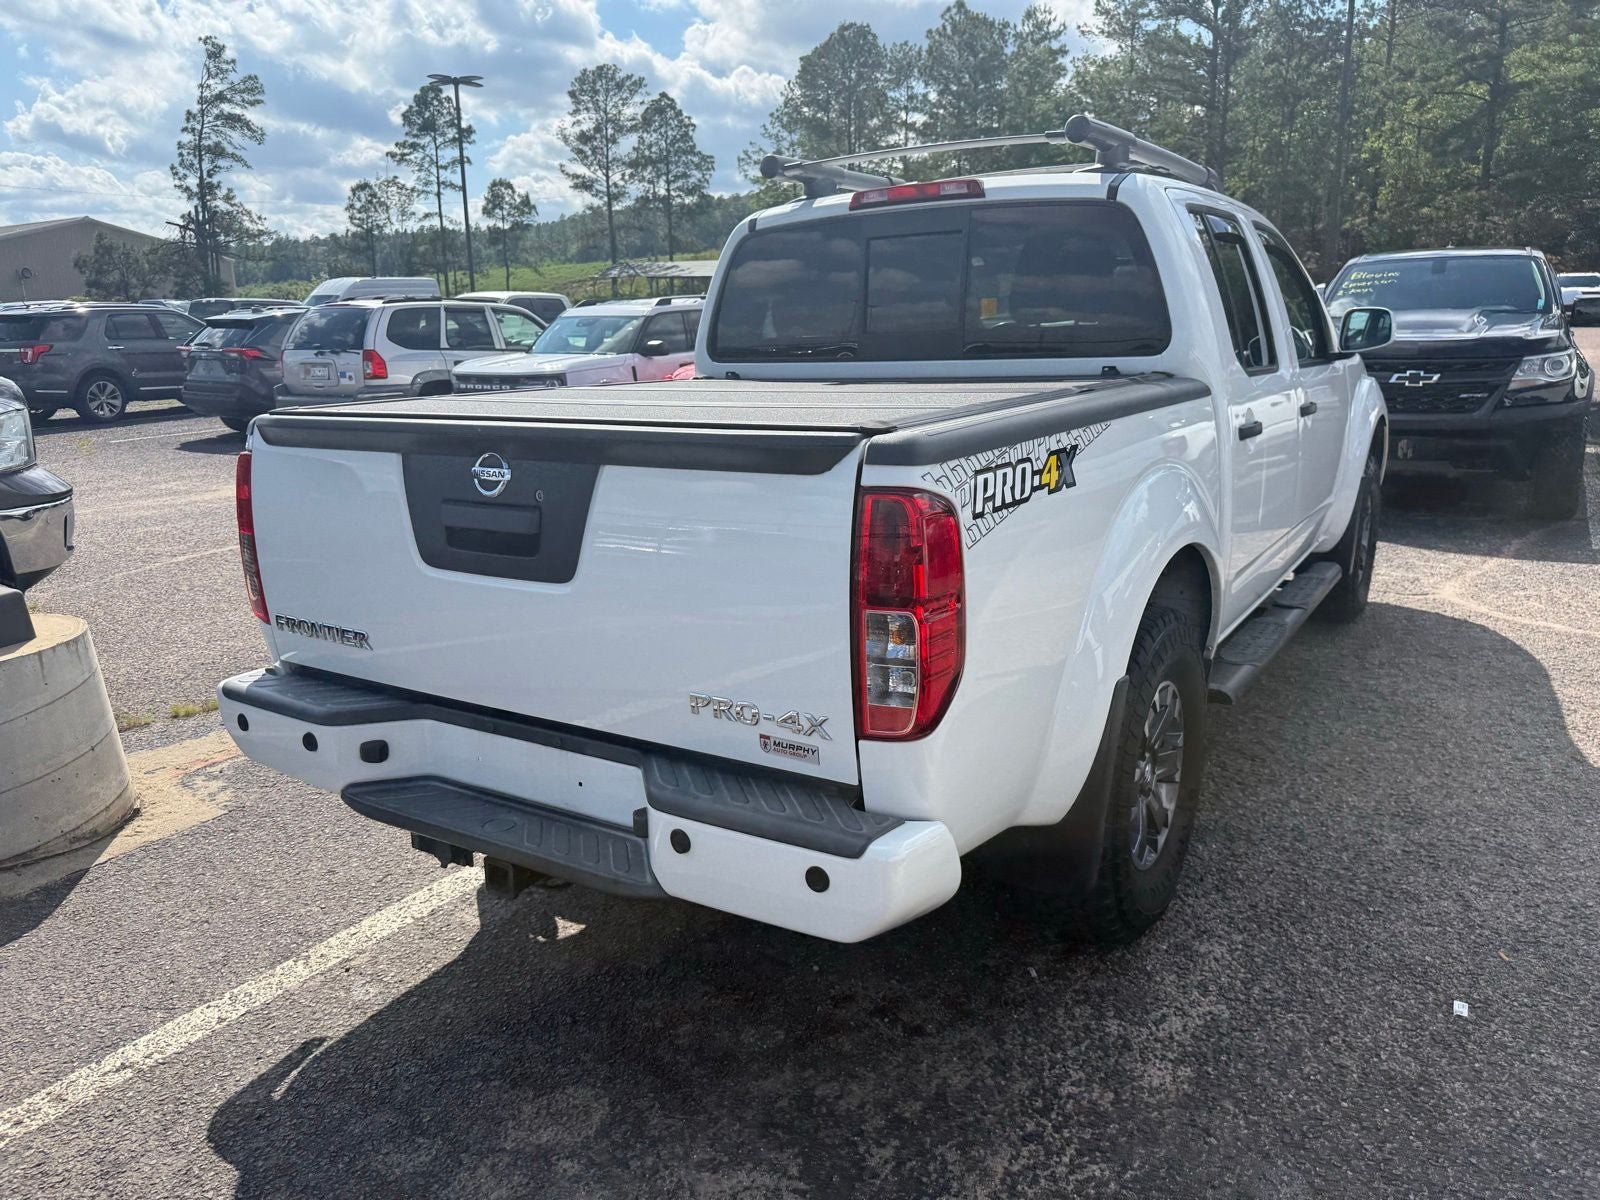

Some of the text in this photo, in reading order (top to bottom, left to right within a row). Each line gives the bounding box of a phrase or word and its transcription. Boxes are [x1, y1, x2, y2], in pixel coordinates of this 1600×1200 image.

[472, 467, 506, 479] NISSAN
[972, 444, 1078, 520] PRO-4X
[275, 613, 374, 651] FRONTIER
[689, 692, 833, 741] PRO-4X
[772, 740, 817, 756] MURPHY
[772, 747, 808, 760] AUTO GROUP
